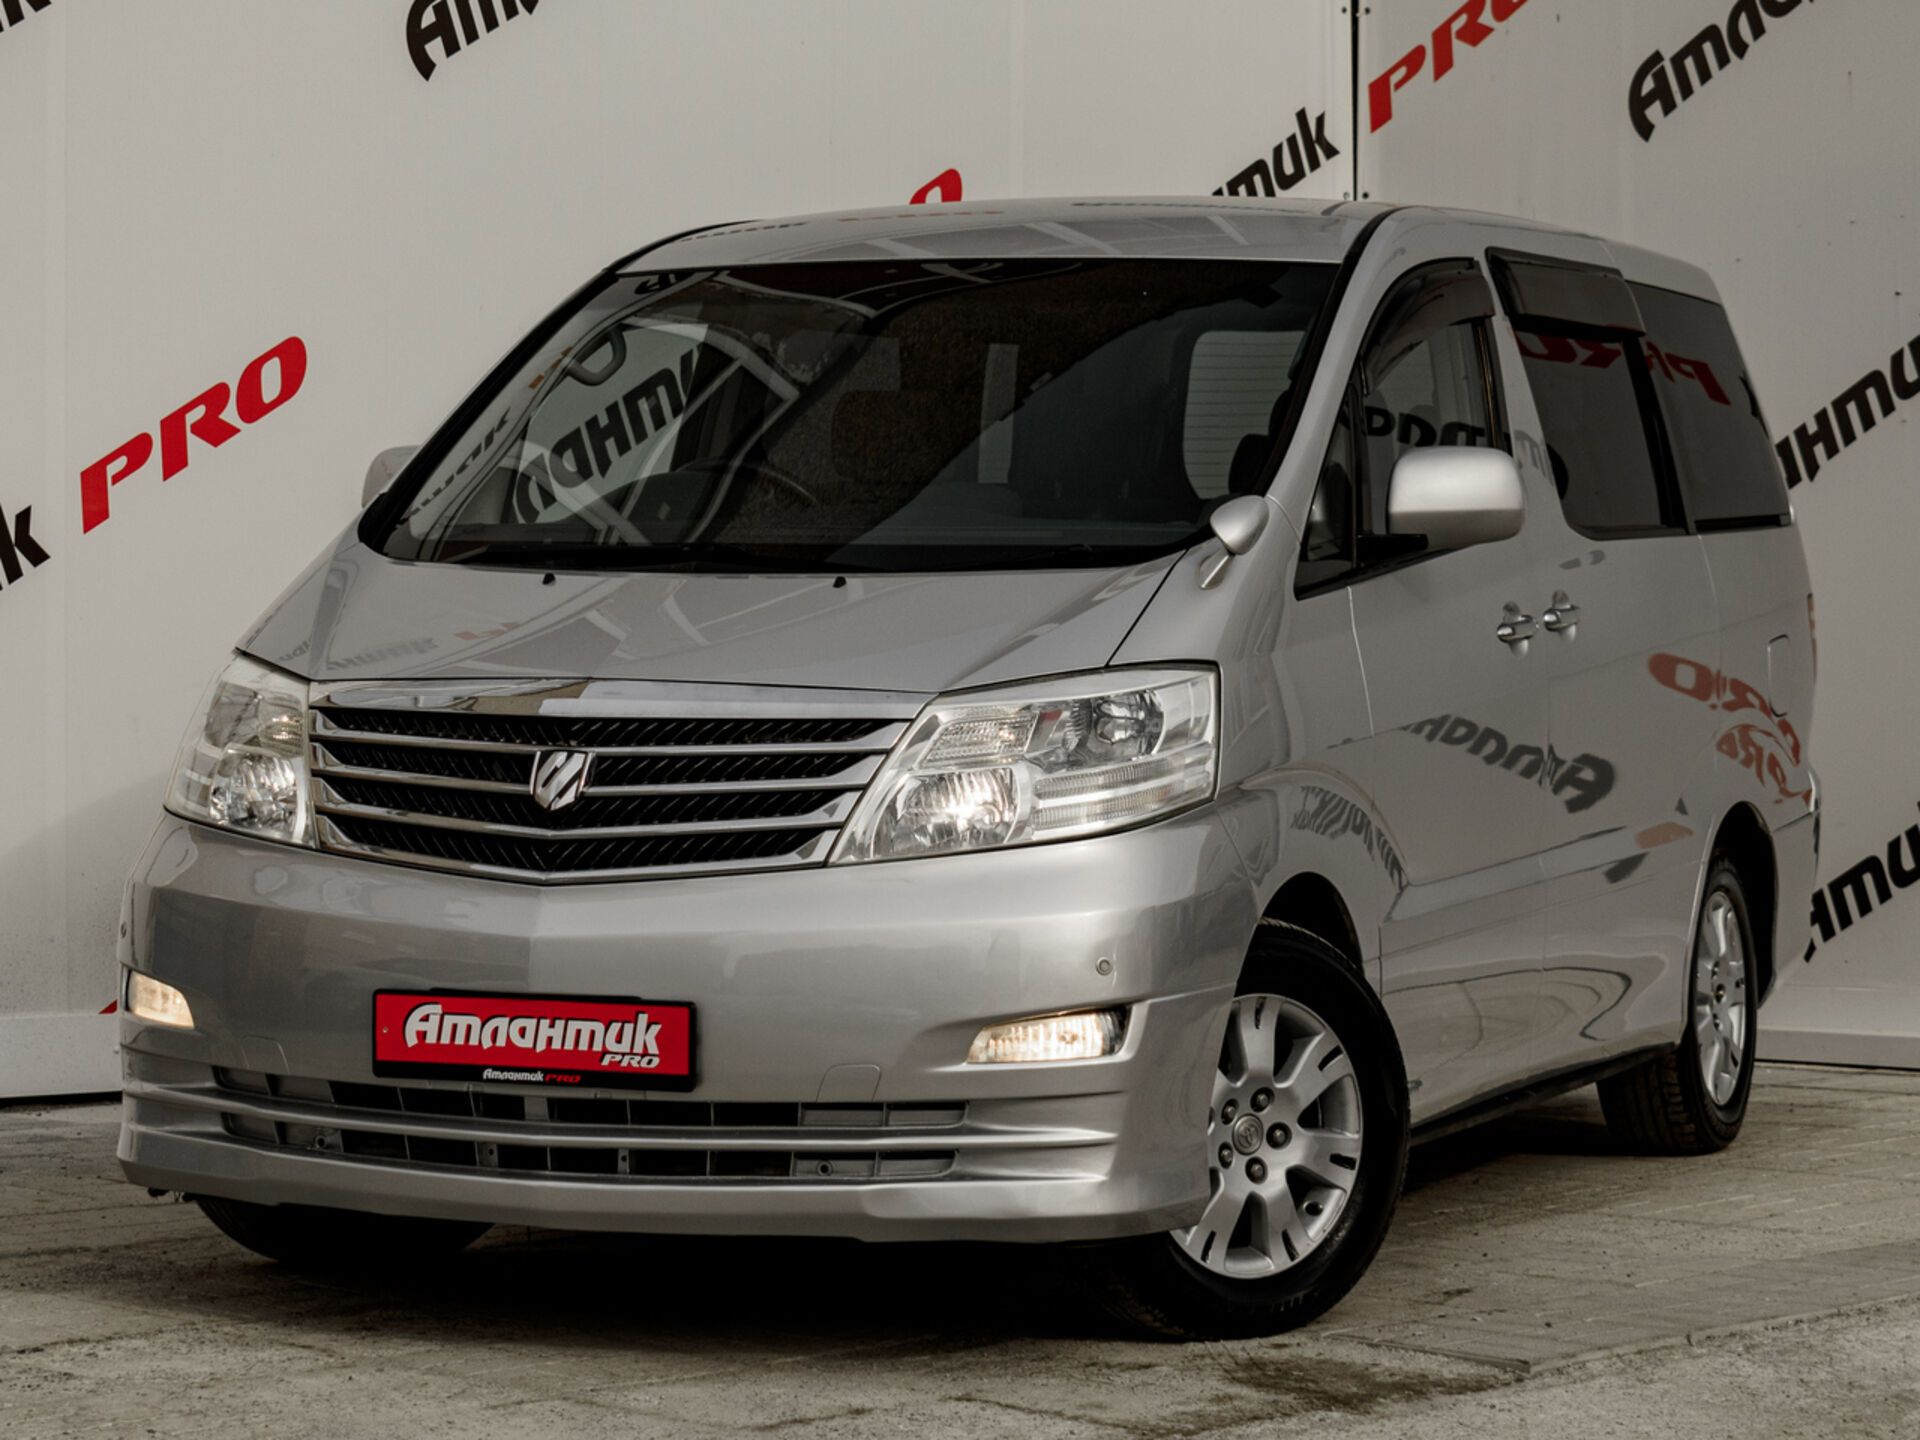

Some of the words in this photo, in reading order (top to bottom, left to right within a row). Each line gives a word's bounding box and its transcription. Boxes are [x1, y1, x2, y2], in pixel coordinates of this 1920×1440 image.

[1368, 0, 1529, 133] PR
[1212, 106, 1341, 197] тик
[81, 336, 307, 534] PRO
[404, 1002, 662, 1055] Атлантик
[600, 1053, 661, 1068] PRO
[482, 1067, 544, 1082] Атлантик
[545, 1073, 582, 1084] PRO
